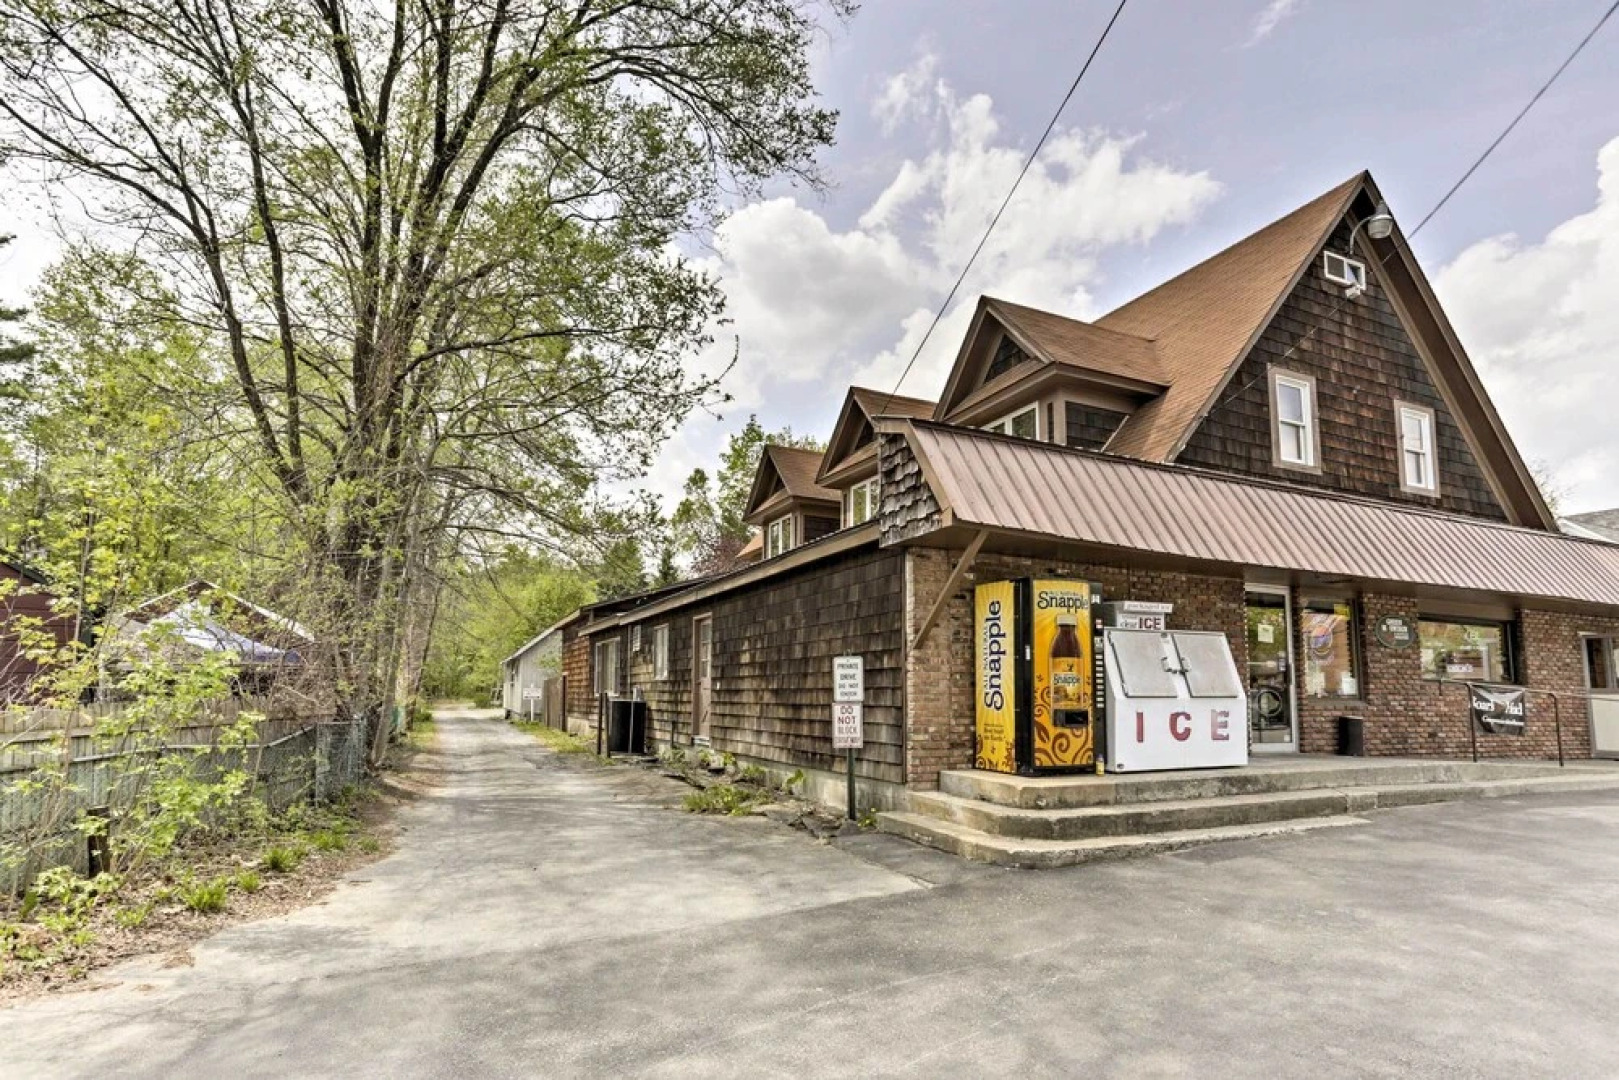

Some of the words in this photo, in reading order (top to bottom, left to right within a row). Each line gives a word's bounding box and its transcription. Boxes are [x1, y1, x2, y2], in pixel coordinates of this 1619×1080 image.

[1037, 591, 1089, 614] Snapple
[1139, 616, 1161, 629] ICE
[984, 600, 1006, 711] Snapple
[840, 705, 853, 714] DO
[838, 716, 856, 724] NOT
[1136, 709, 1230, 743] ICE
